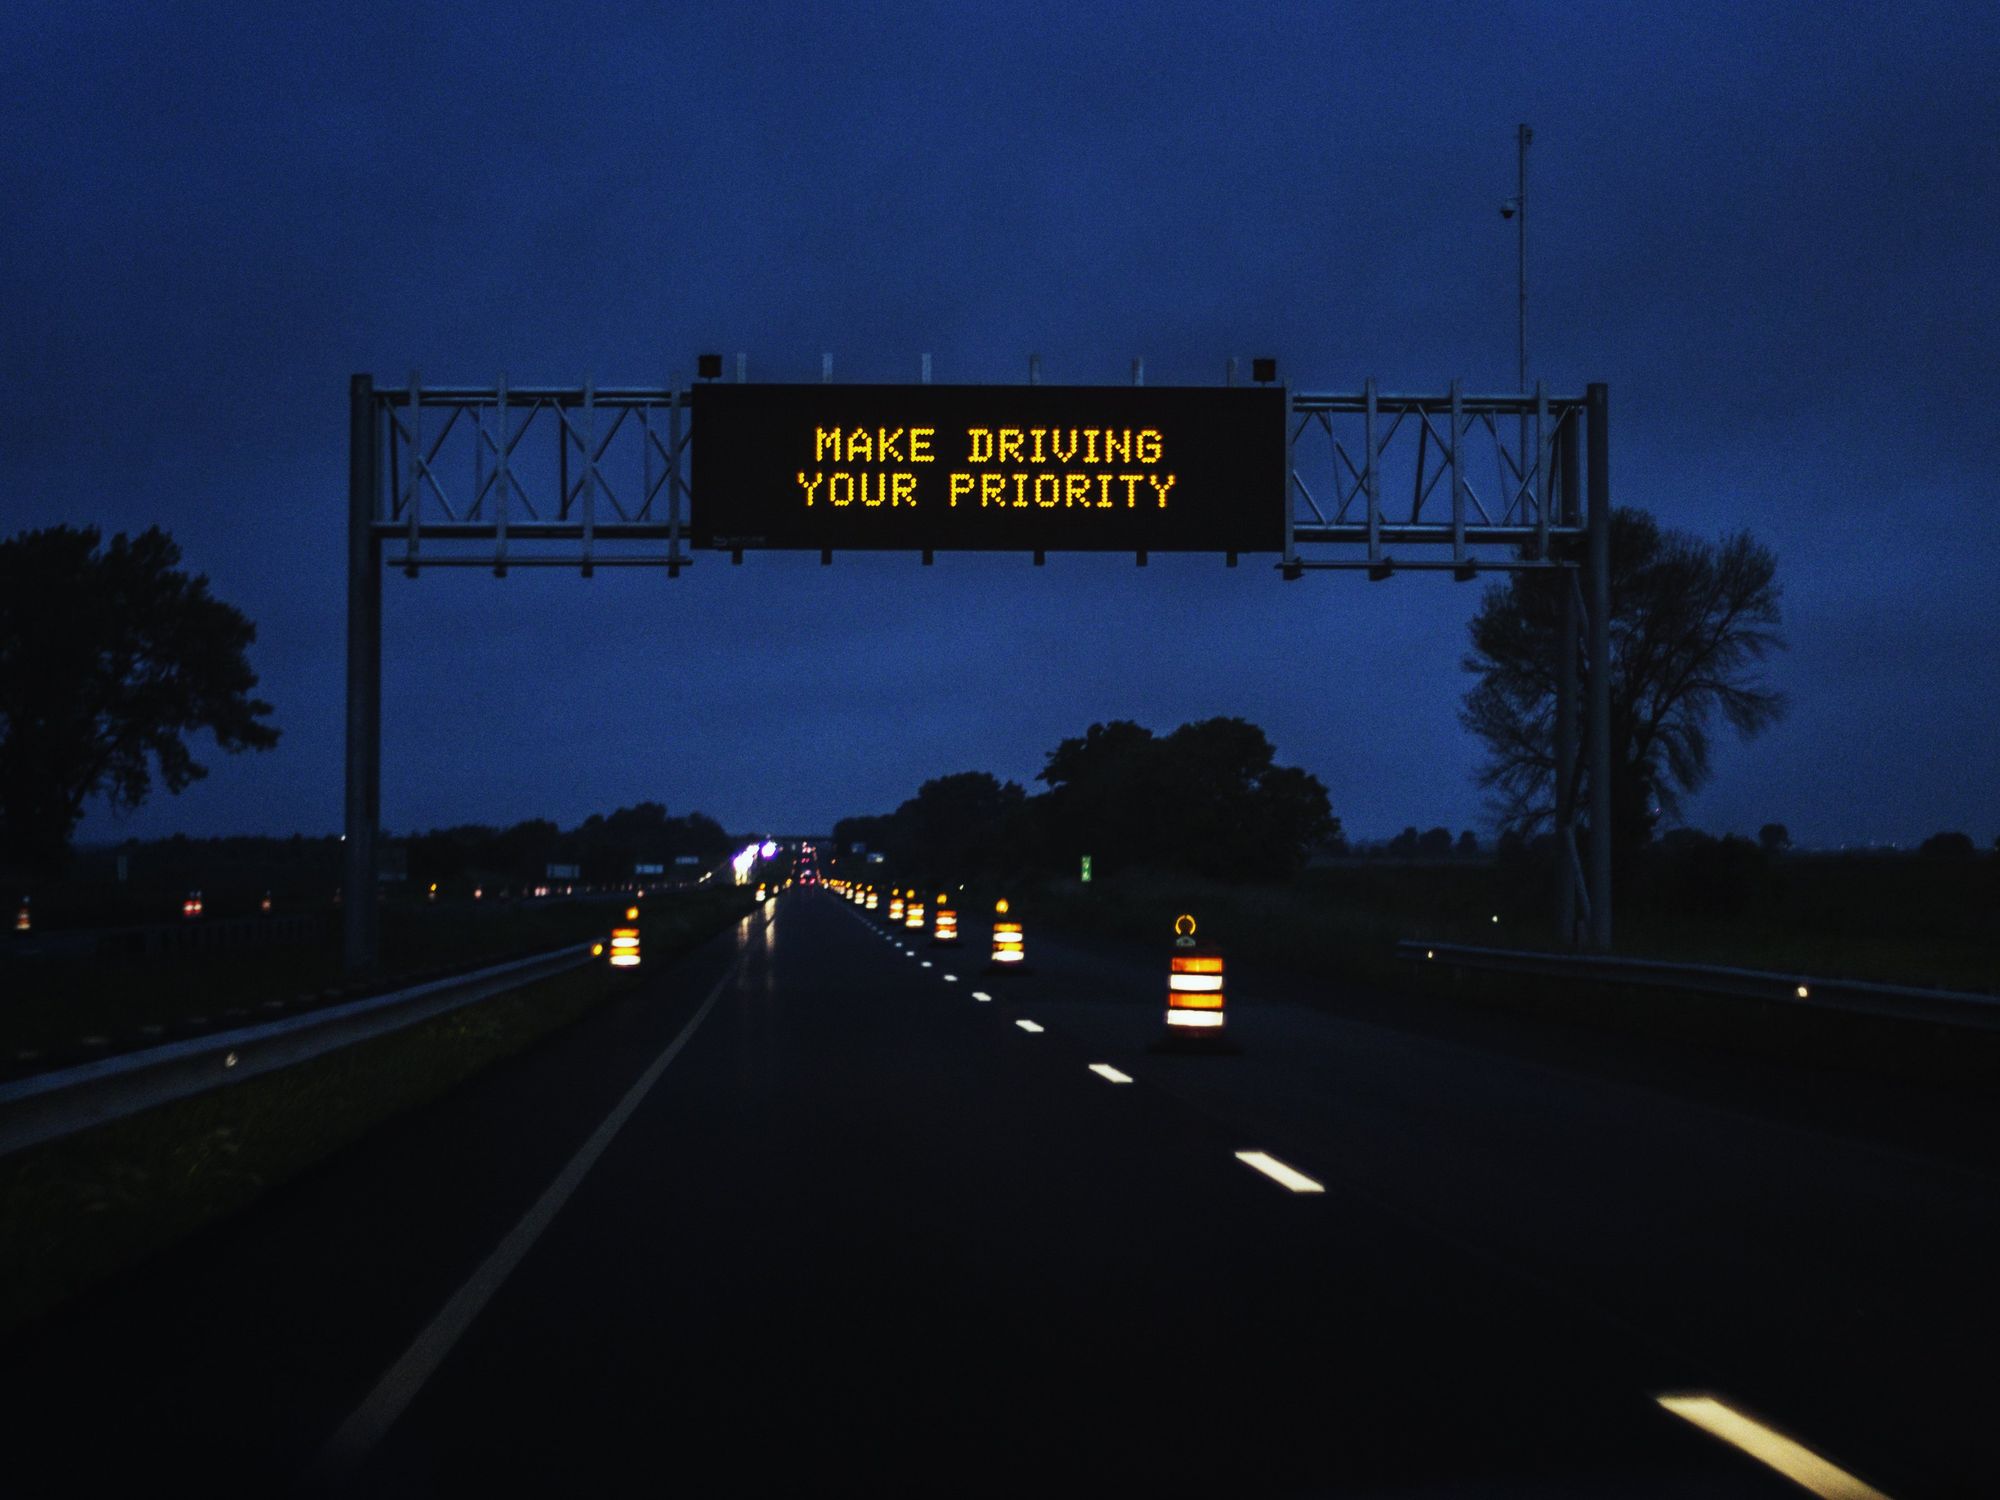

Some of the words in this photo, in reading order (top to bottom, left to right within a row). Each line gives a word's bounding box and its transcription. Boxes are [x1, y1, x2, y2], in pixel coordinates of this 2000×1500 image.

[814, 425, 936, 463] MAKE
[966, 427, 1164, 464] DRIVING
[796, 472, 918, 508] YOUR
[948, 472, 1177, 508] PRIORITY
